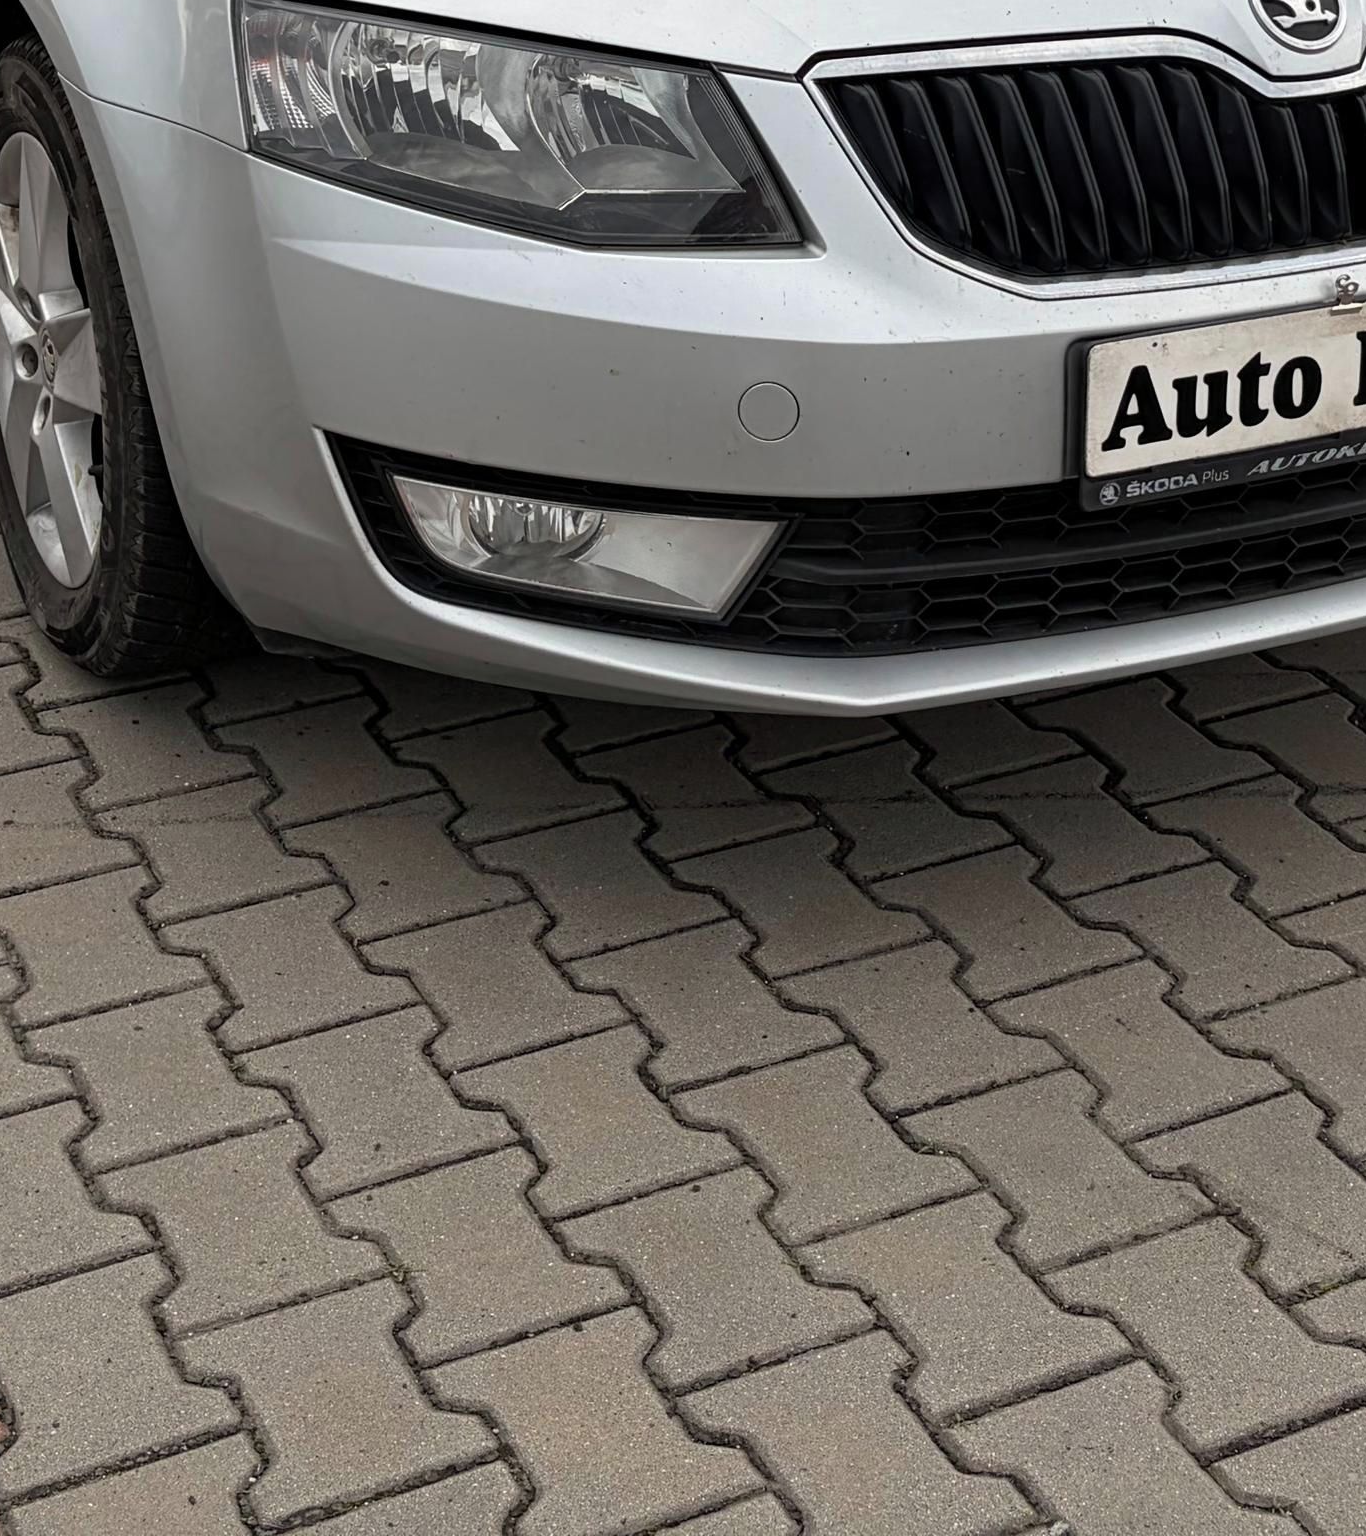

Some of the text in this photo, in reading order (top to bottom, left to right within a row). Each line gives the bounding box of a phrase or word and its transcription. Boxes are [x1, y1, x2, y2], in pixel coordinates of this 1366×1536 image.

[1101, 351, 1323, 453] Auto
[1125, 468, 1231, 498] ŠKODA Plus
